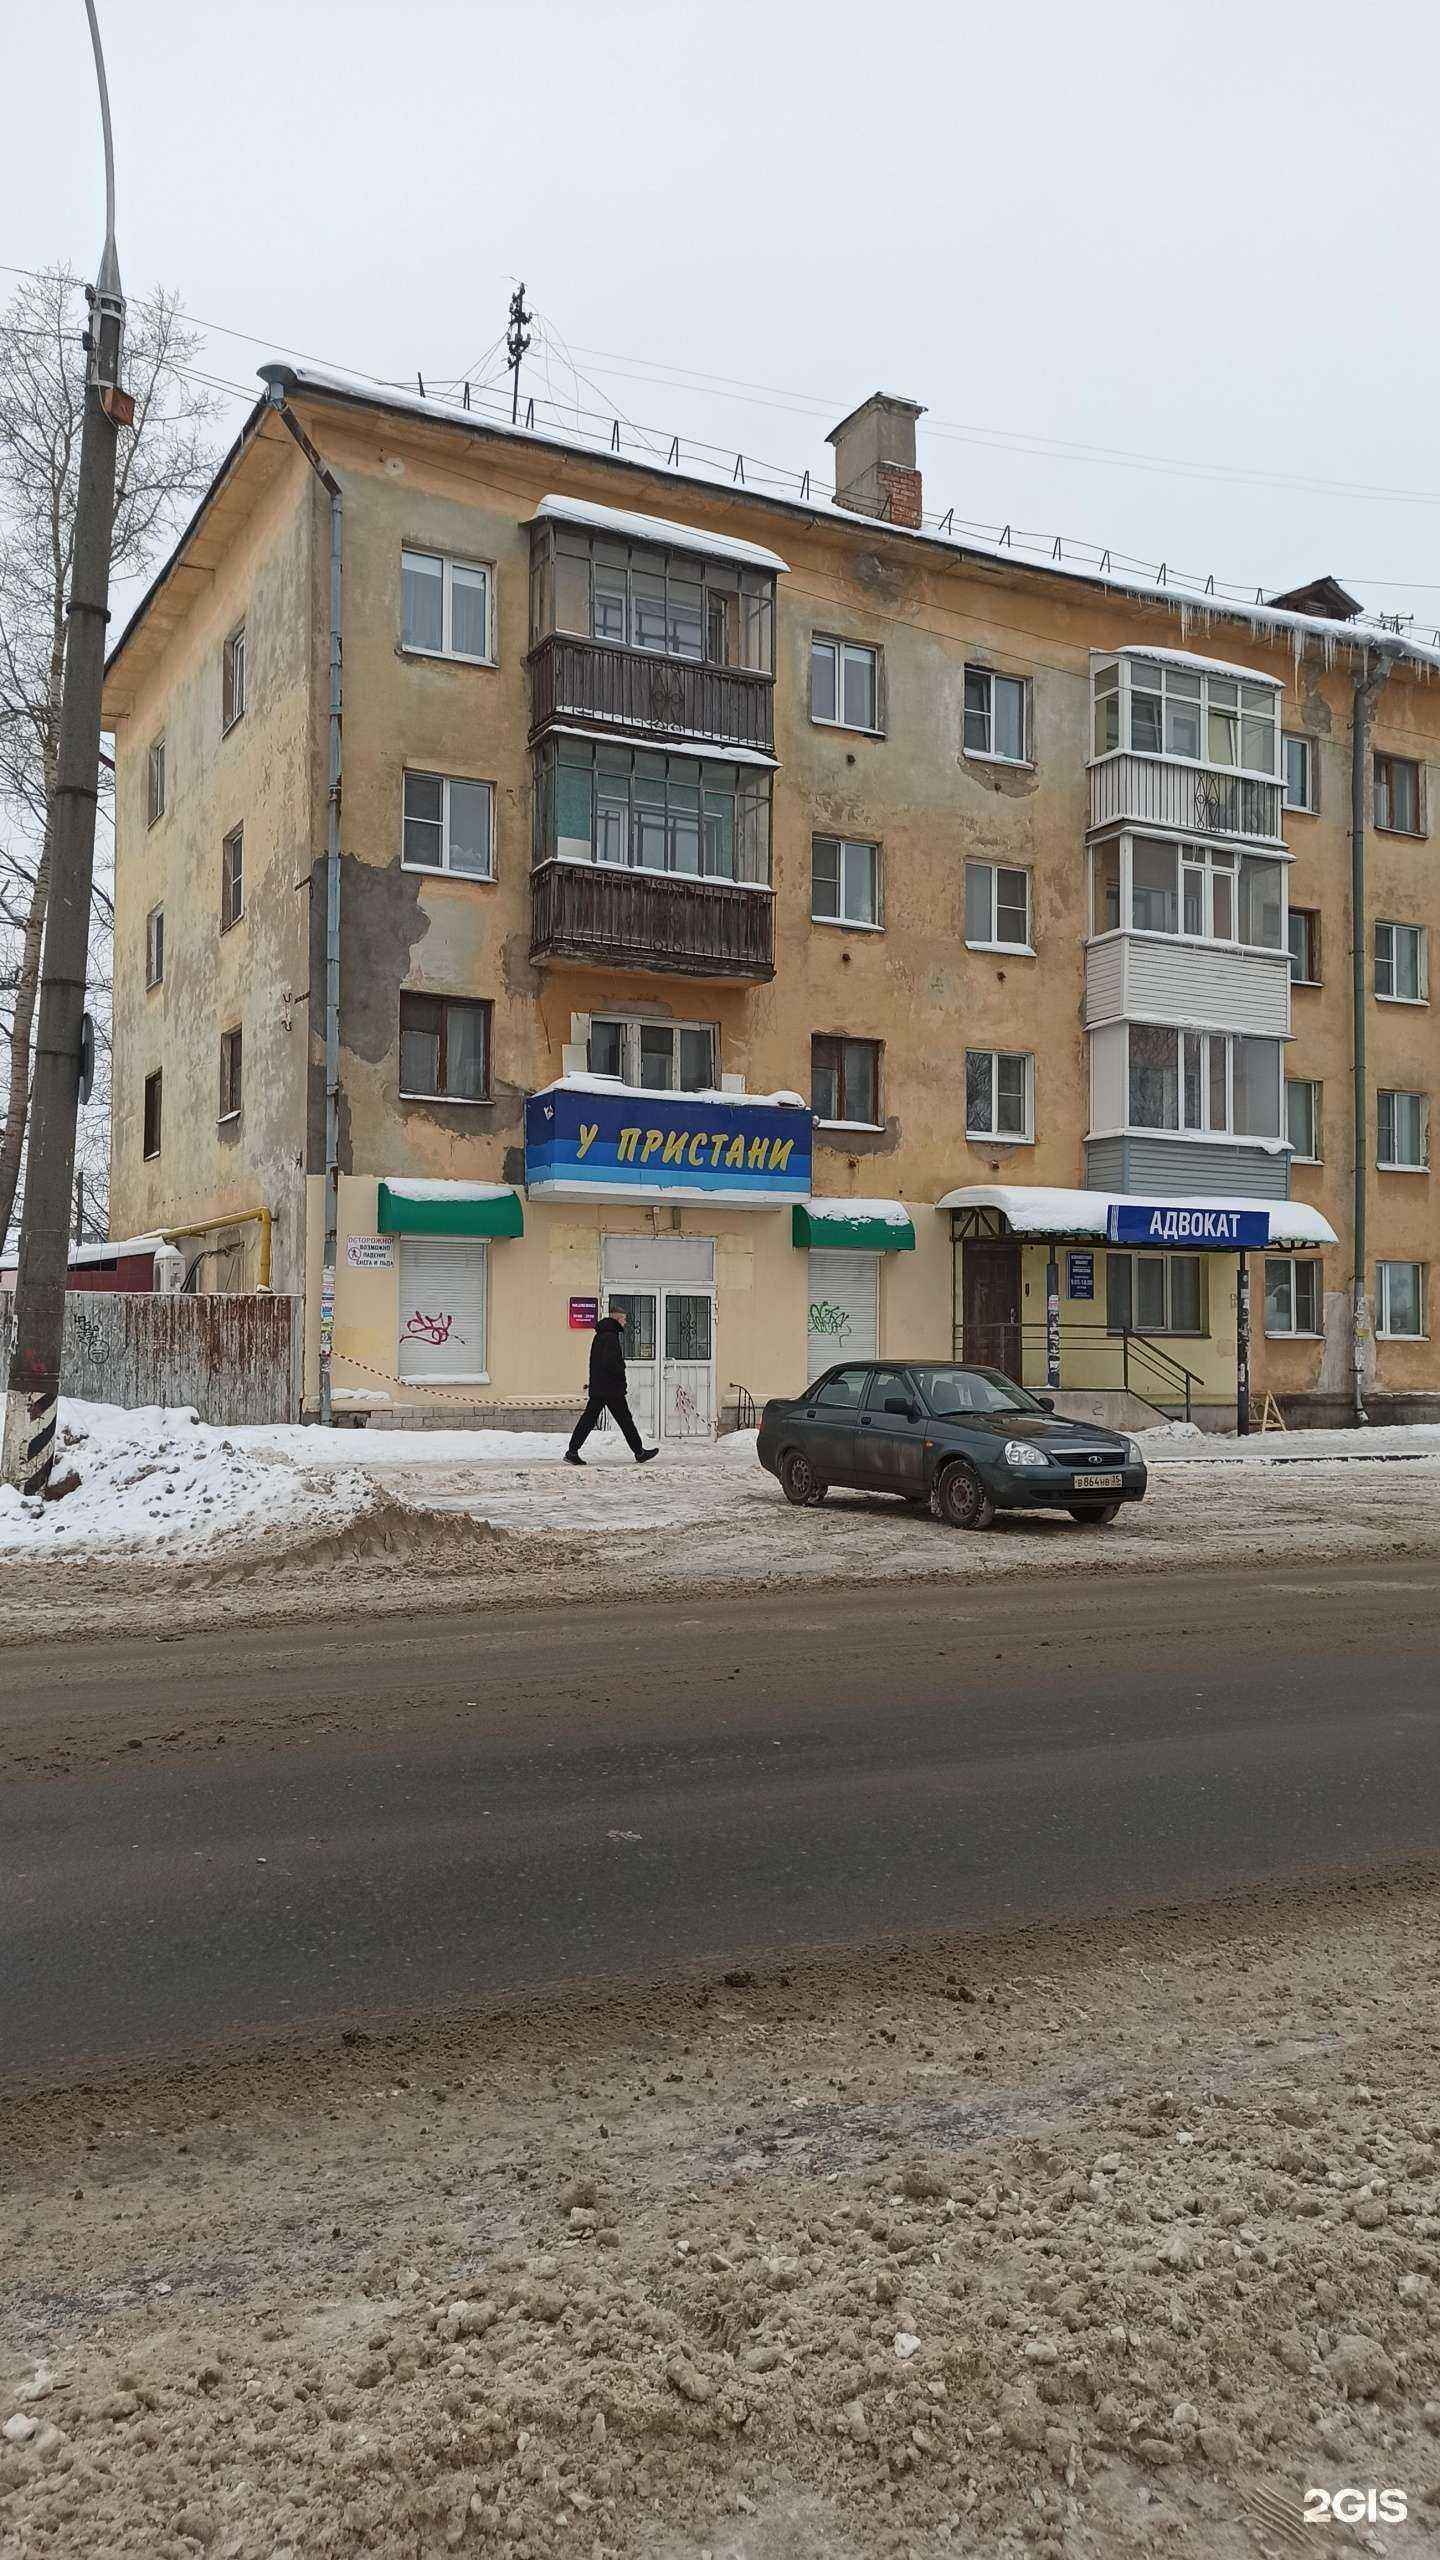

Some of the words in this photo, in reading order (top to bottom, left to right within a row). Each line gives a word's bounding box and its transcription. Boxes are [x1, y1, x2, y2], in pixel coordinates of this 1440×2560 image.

[577, 1124, 598, 1158] У
[617, 1127, 795, 1171] ПРИСТАНИ
[1150, 1210, 1241, 1239] АДВОКАТ
